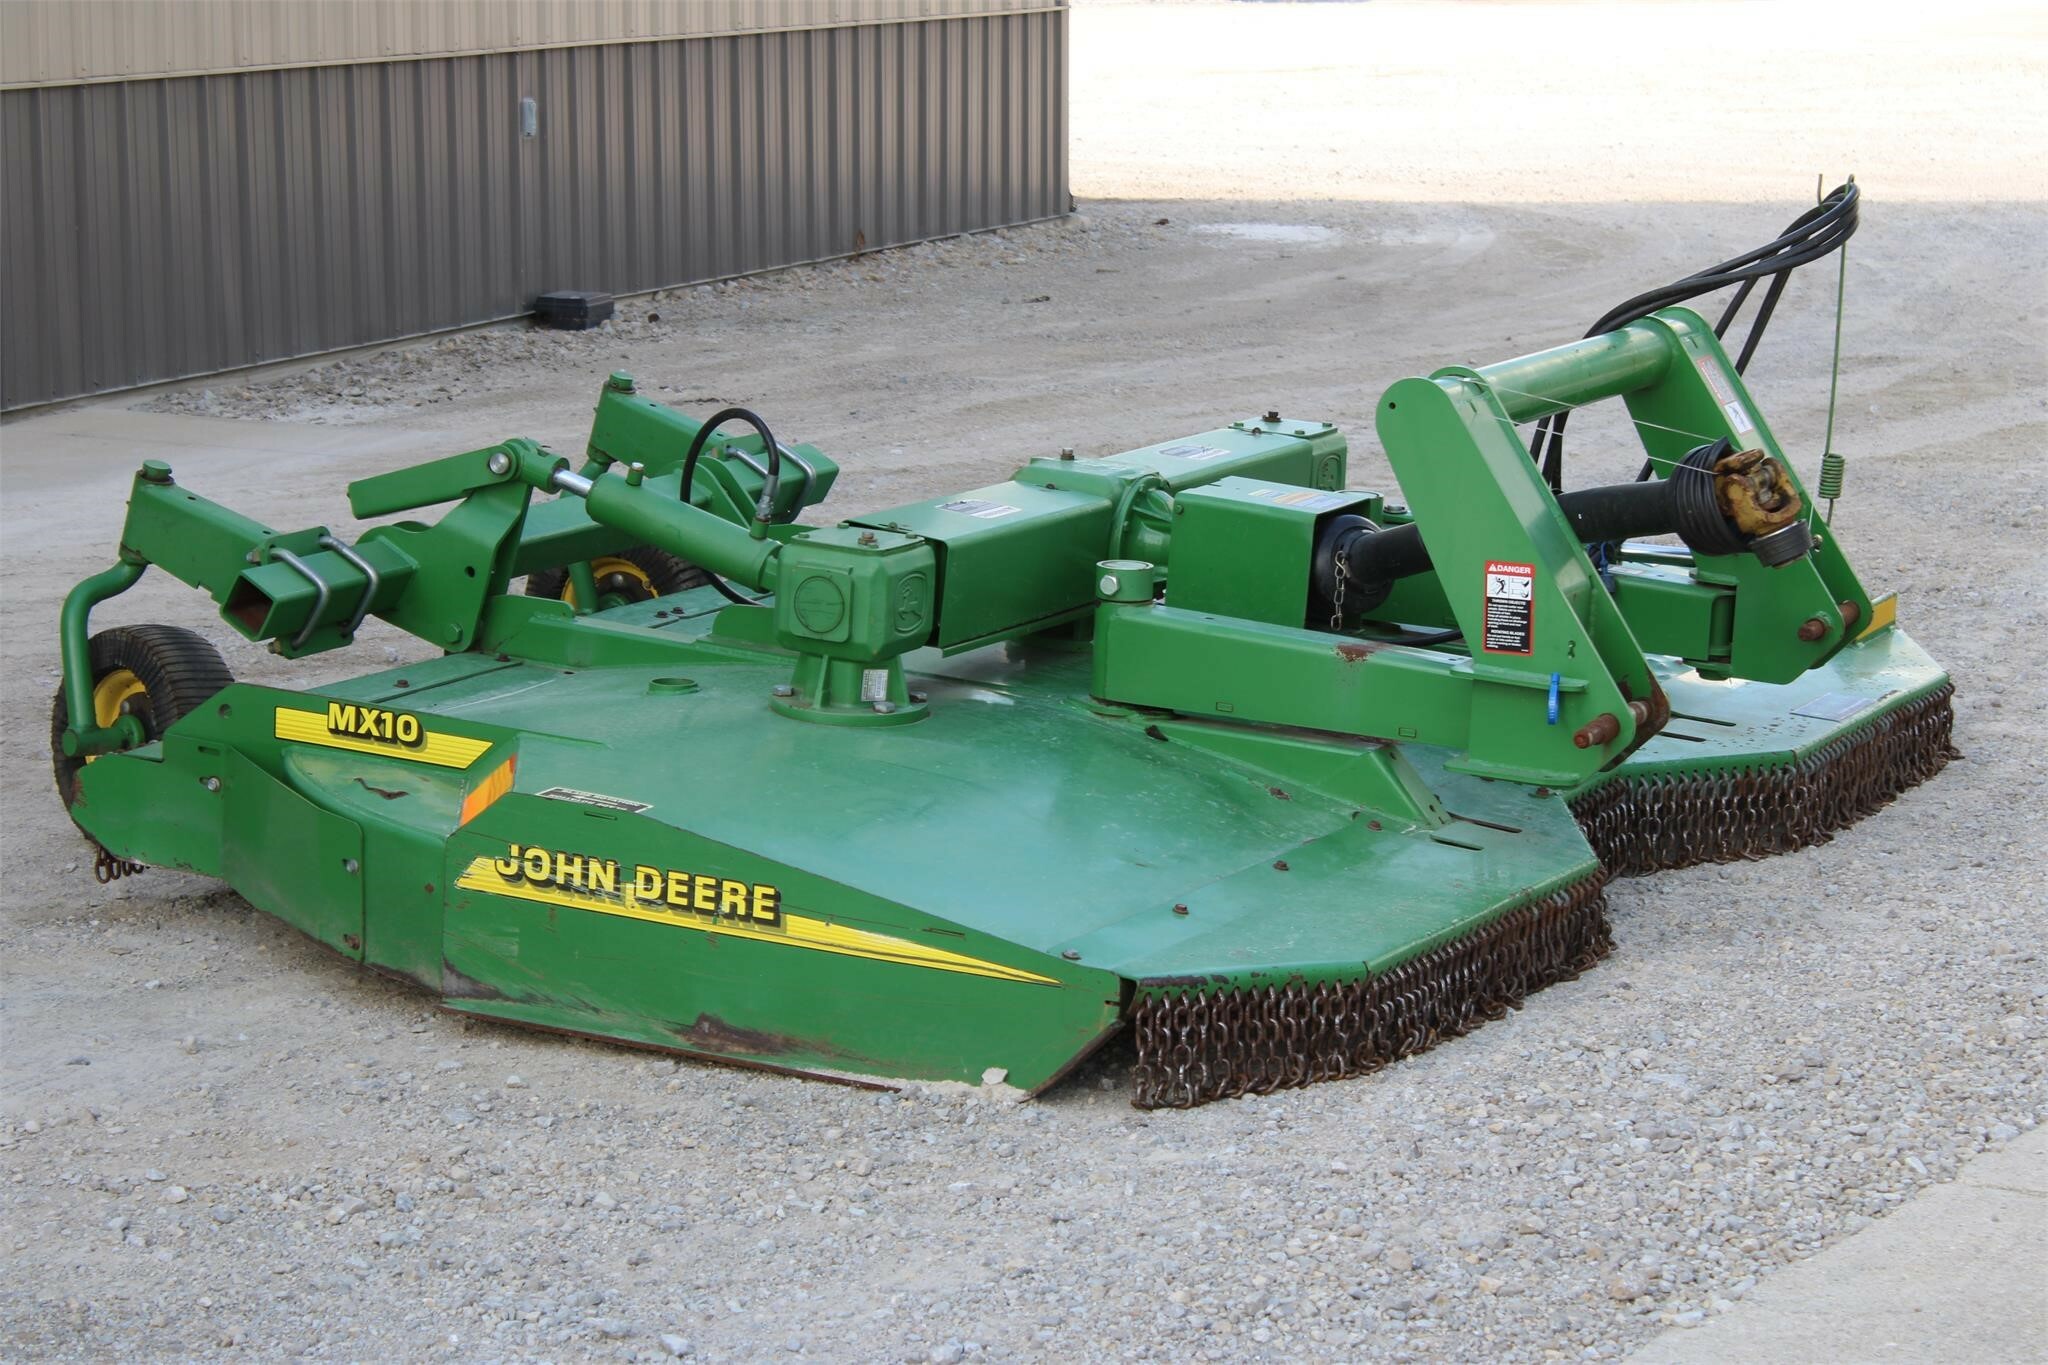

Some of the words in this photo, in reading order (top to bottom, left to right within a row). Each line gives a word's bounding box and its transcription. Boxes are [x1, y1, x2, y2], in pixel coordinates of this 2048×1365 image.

[1497, 564, 1531, 574] DANGER
[328, 702, 419, 743] MX10
[495, 844, 618, 892] JOHN
[635, 864, 777, 921] DEERE
